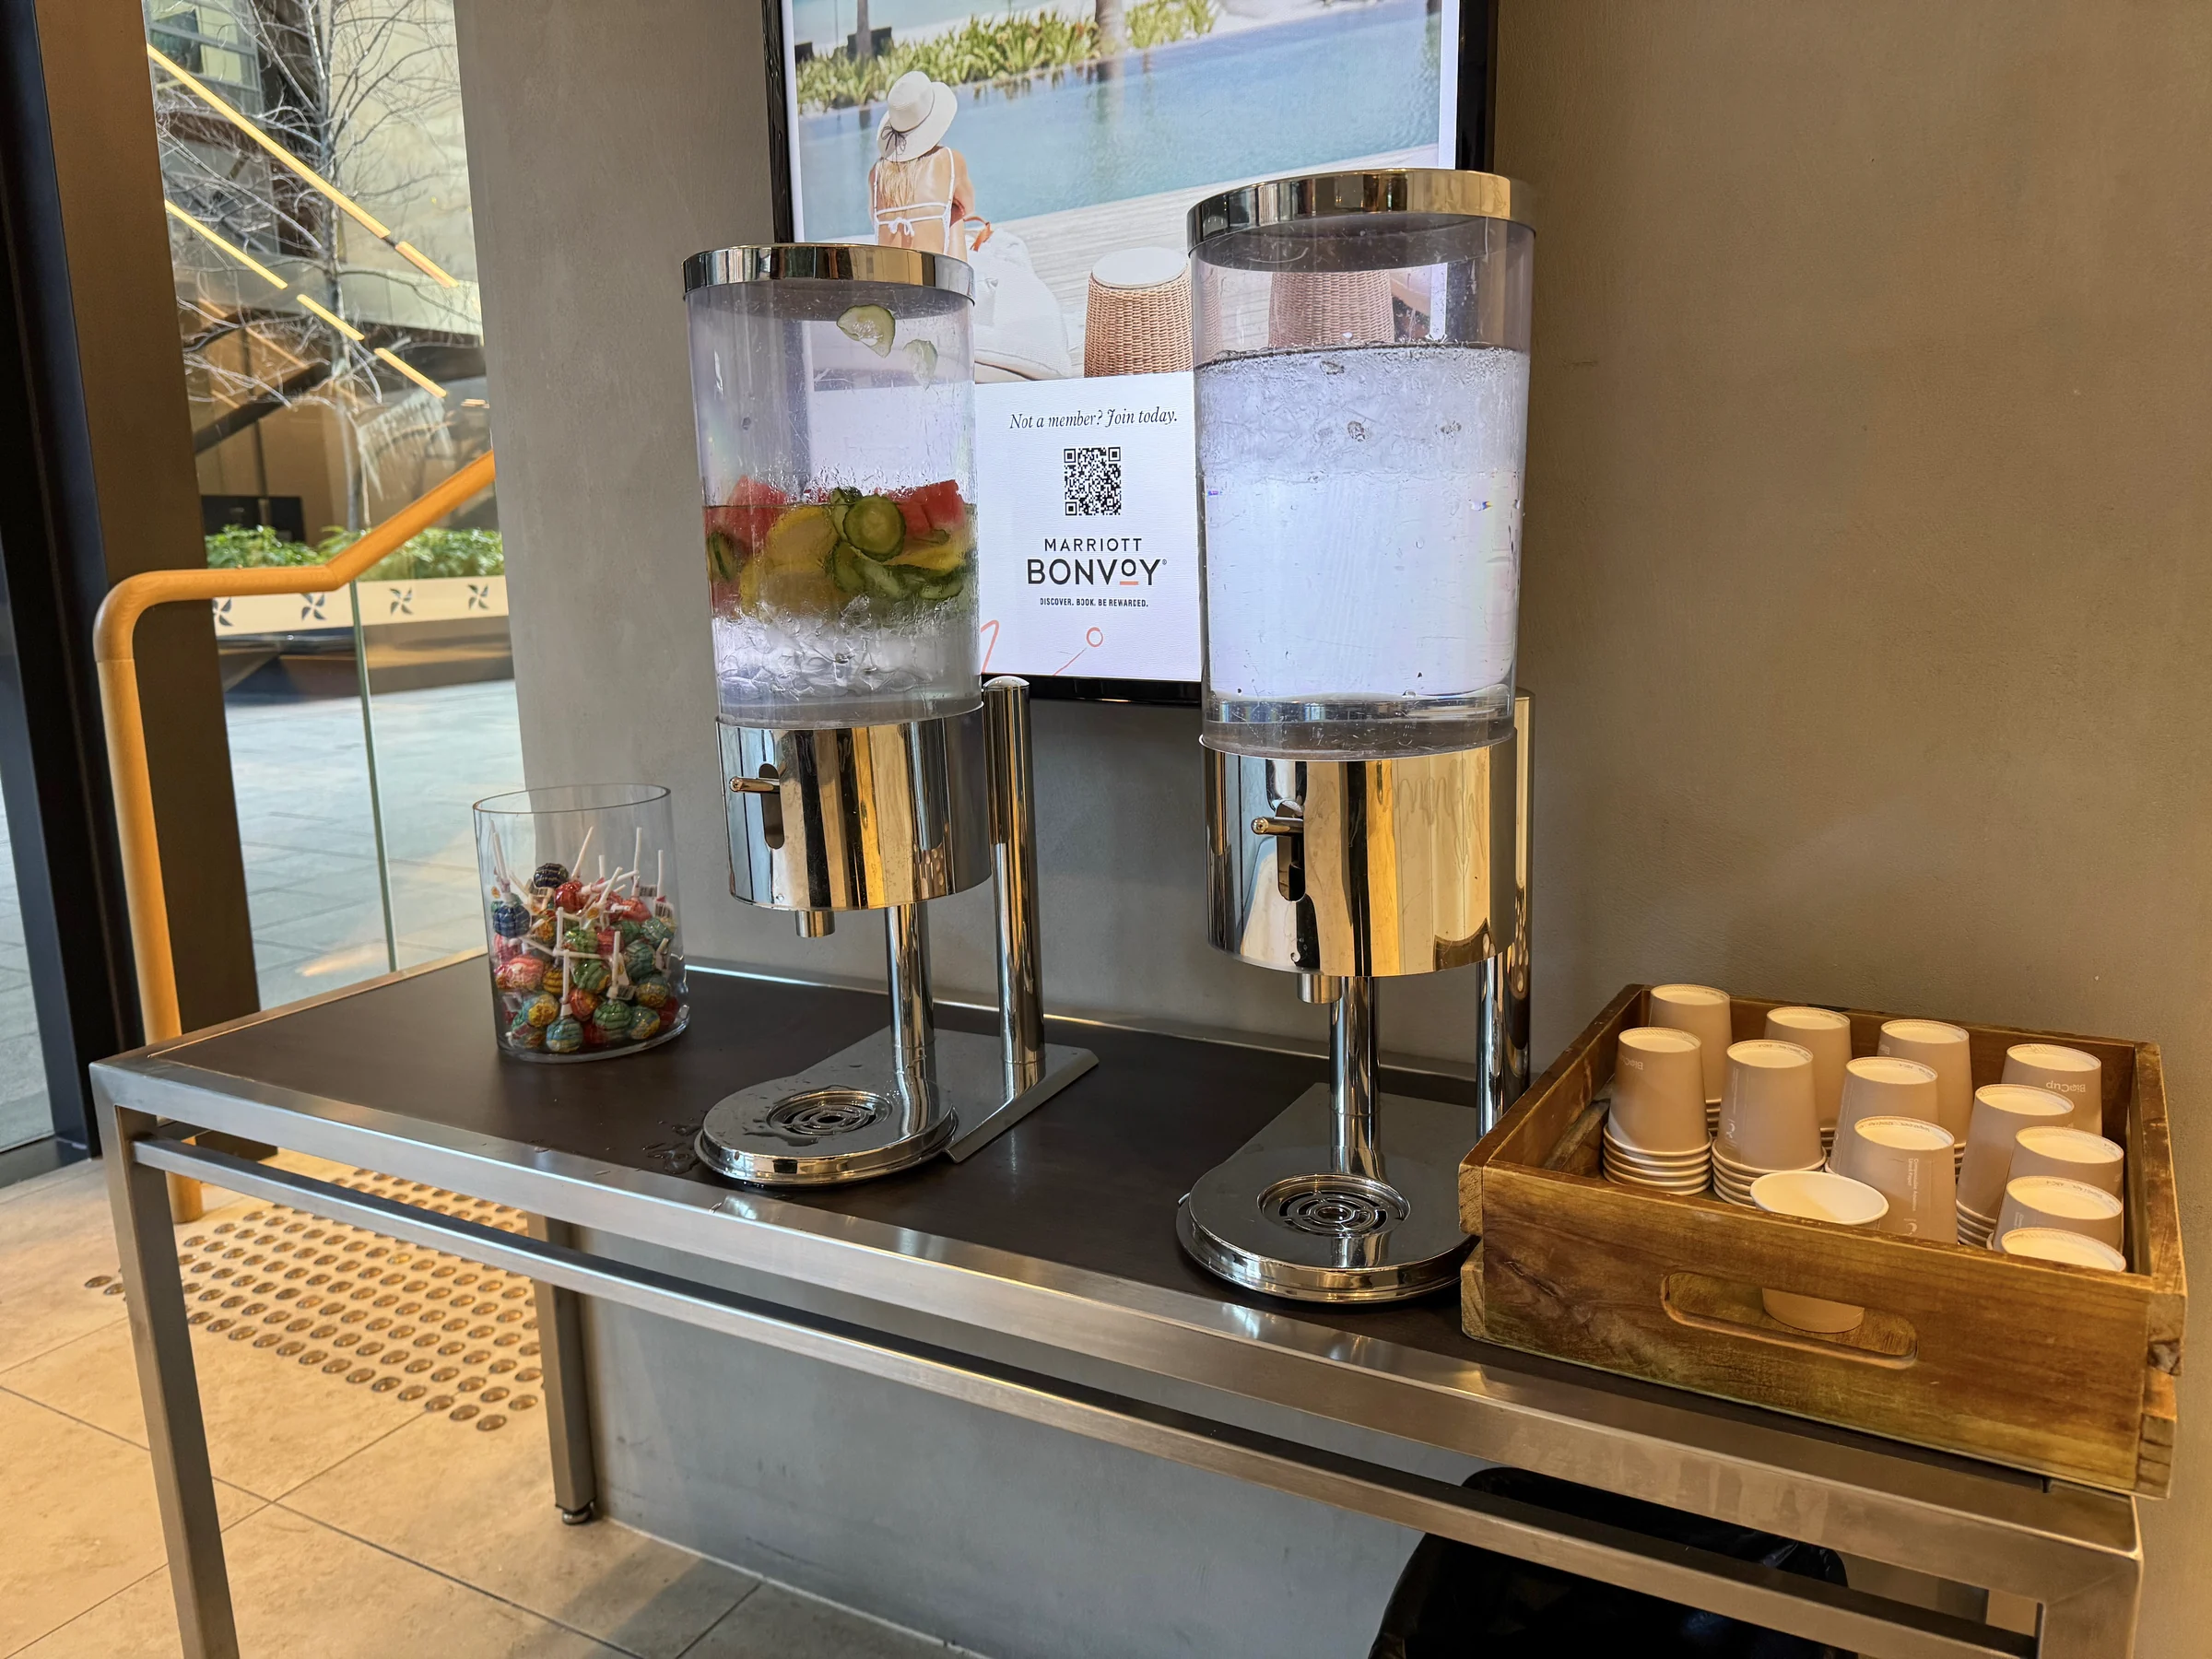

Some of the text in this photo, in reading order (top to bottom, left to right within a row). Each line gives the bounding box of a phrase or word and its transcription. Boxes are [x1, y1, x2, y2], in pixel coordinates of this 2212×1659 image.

[1009, 406, 1178, 429] Not a member? Join today.
[1043, 537, 1143, 553] MARRIOTT
[1040, 597, 1149, 608] DISCOVER. BOOK. BE REWARDED.
[2045, 1080, 2086, 1093] BioCup
